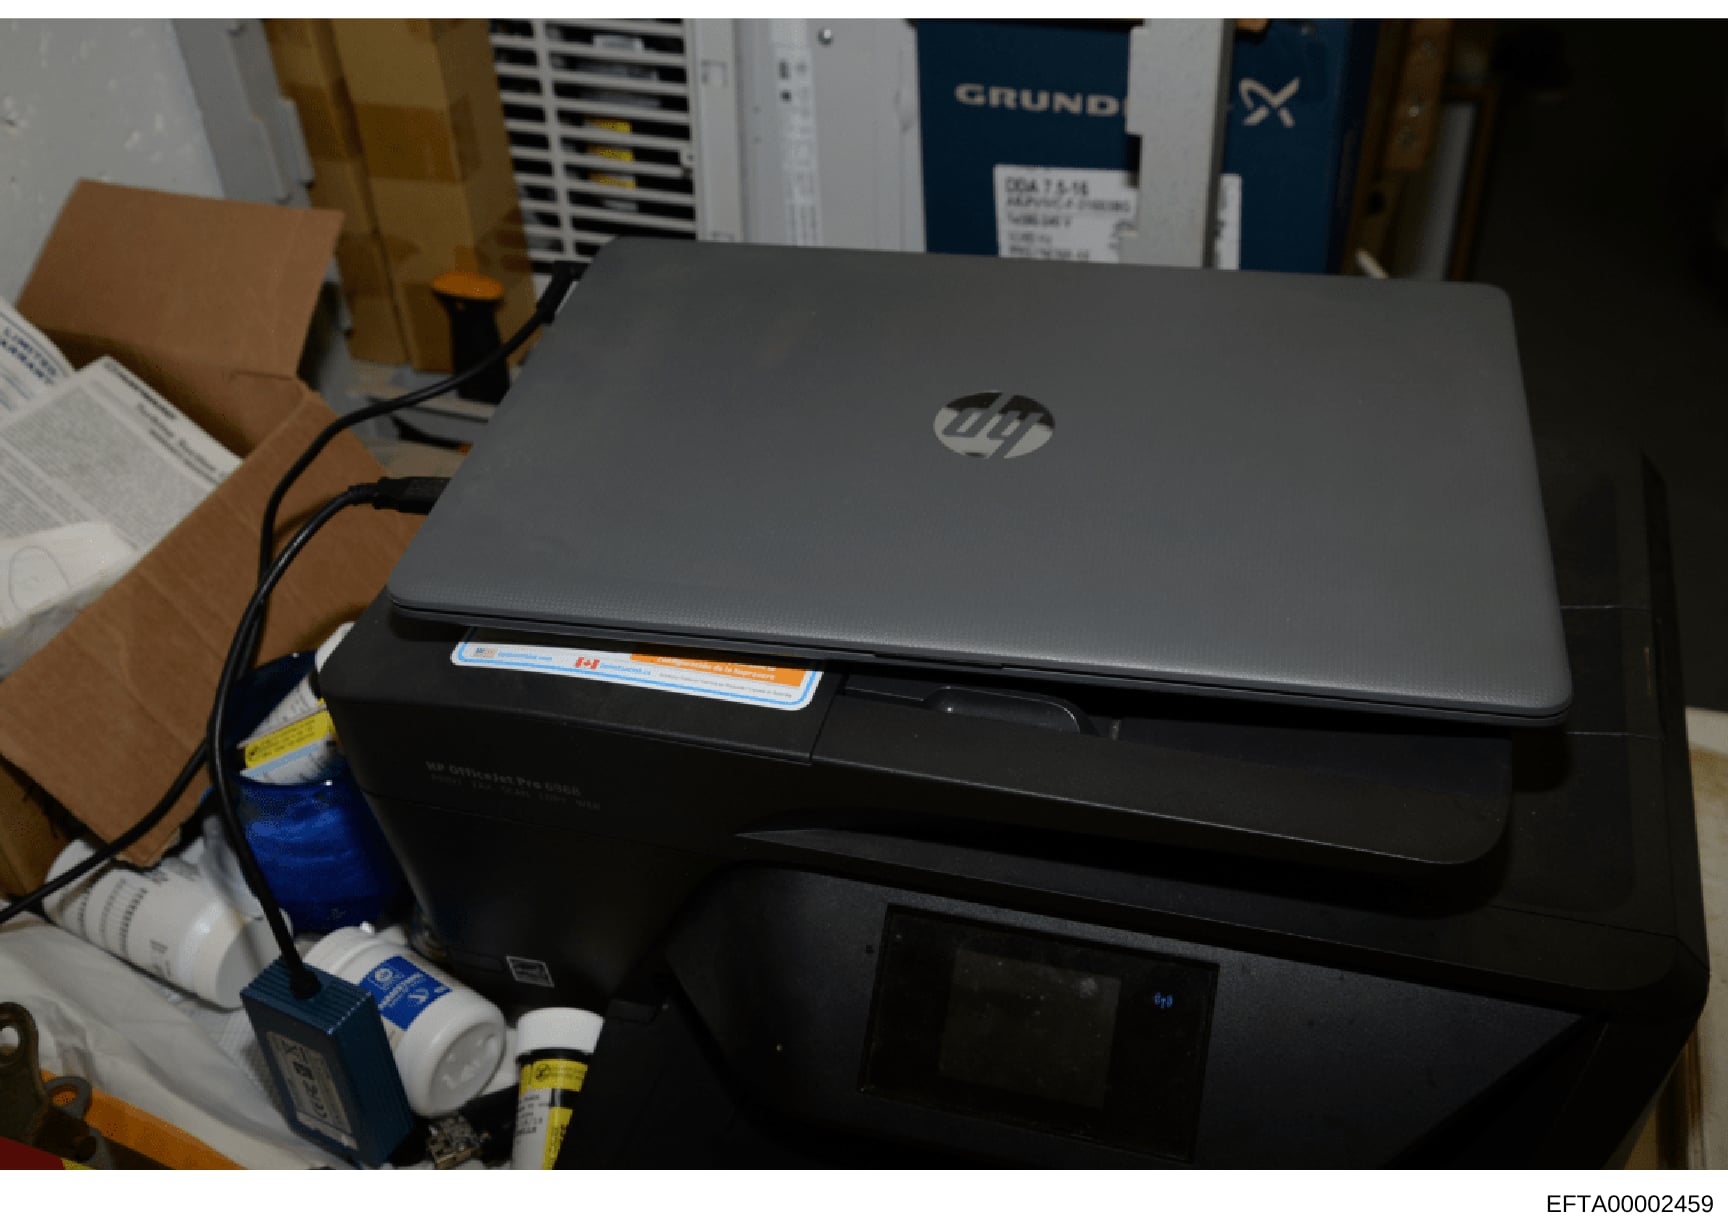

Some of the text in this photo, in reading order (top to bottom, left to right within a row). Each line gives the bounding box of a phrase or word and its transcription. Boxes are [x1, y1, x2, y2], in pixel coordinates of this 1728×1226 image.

[954, 82, 1127, 117] GRUND
[425, 760, 445, 773] HP
[515, 774, 542, 790] Pro
